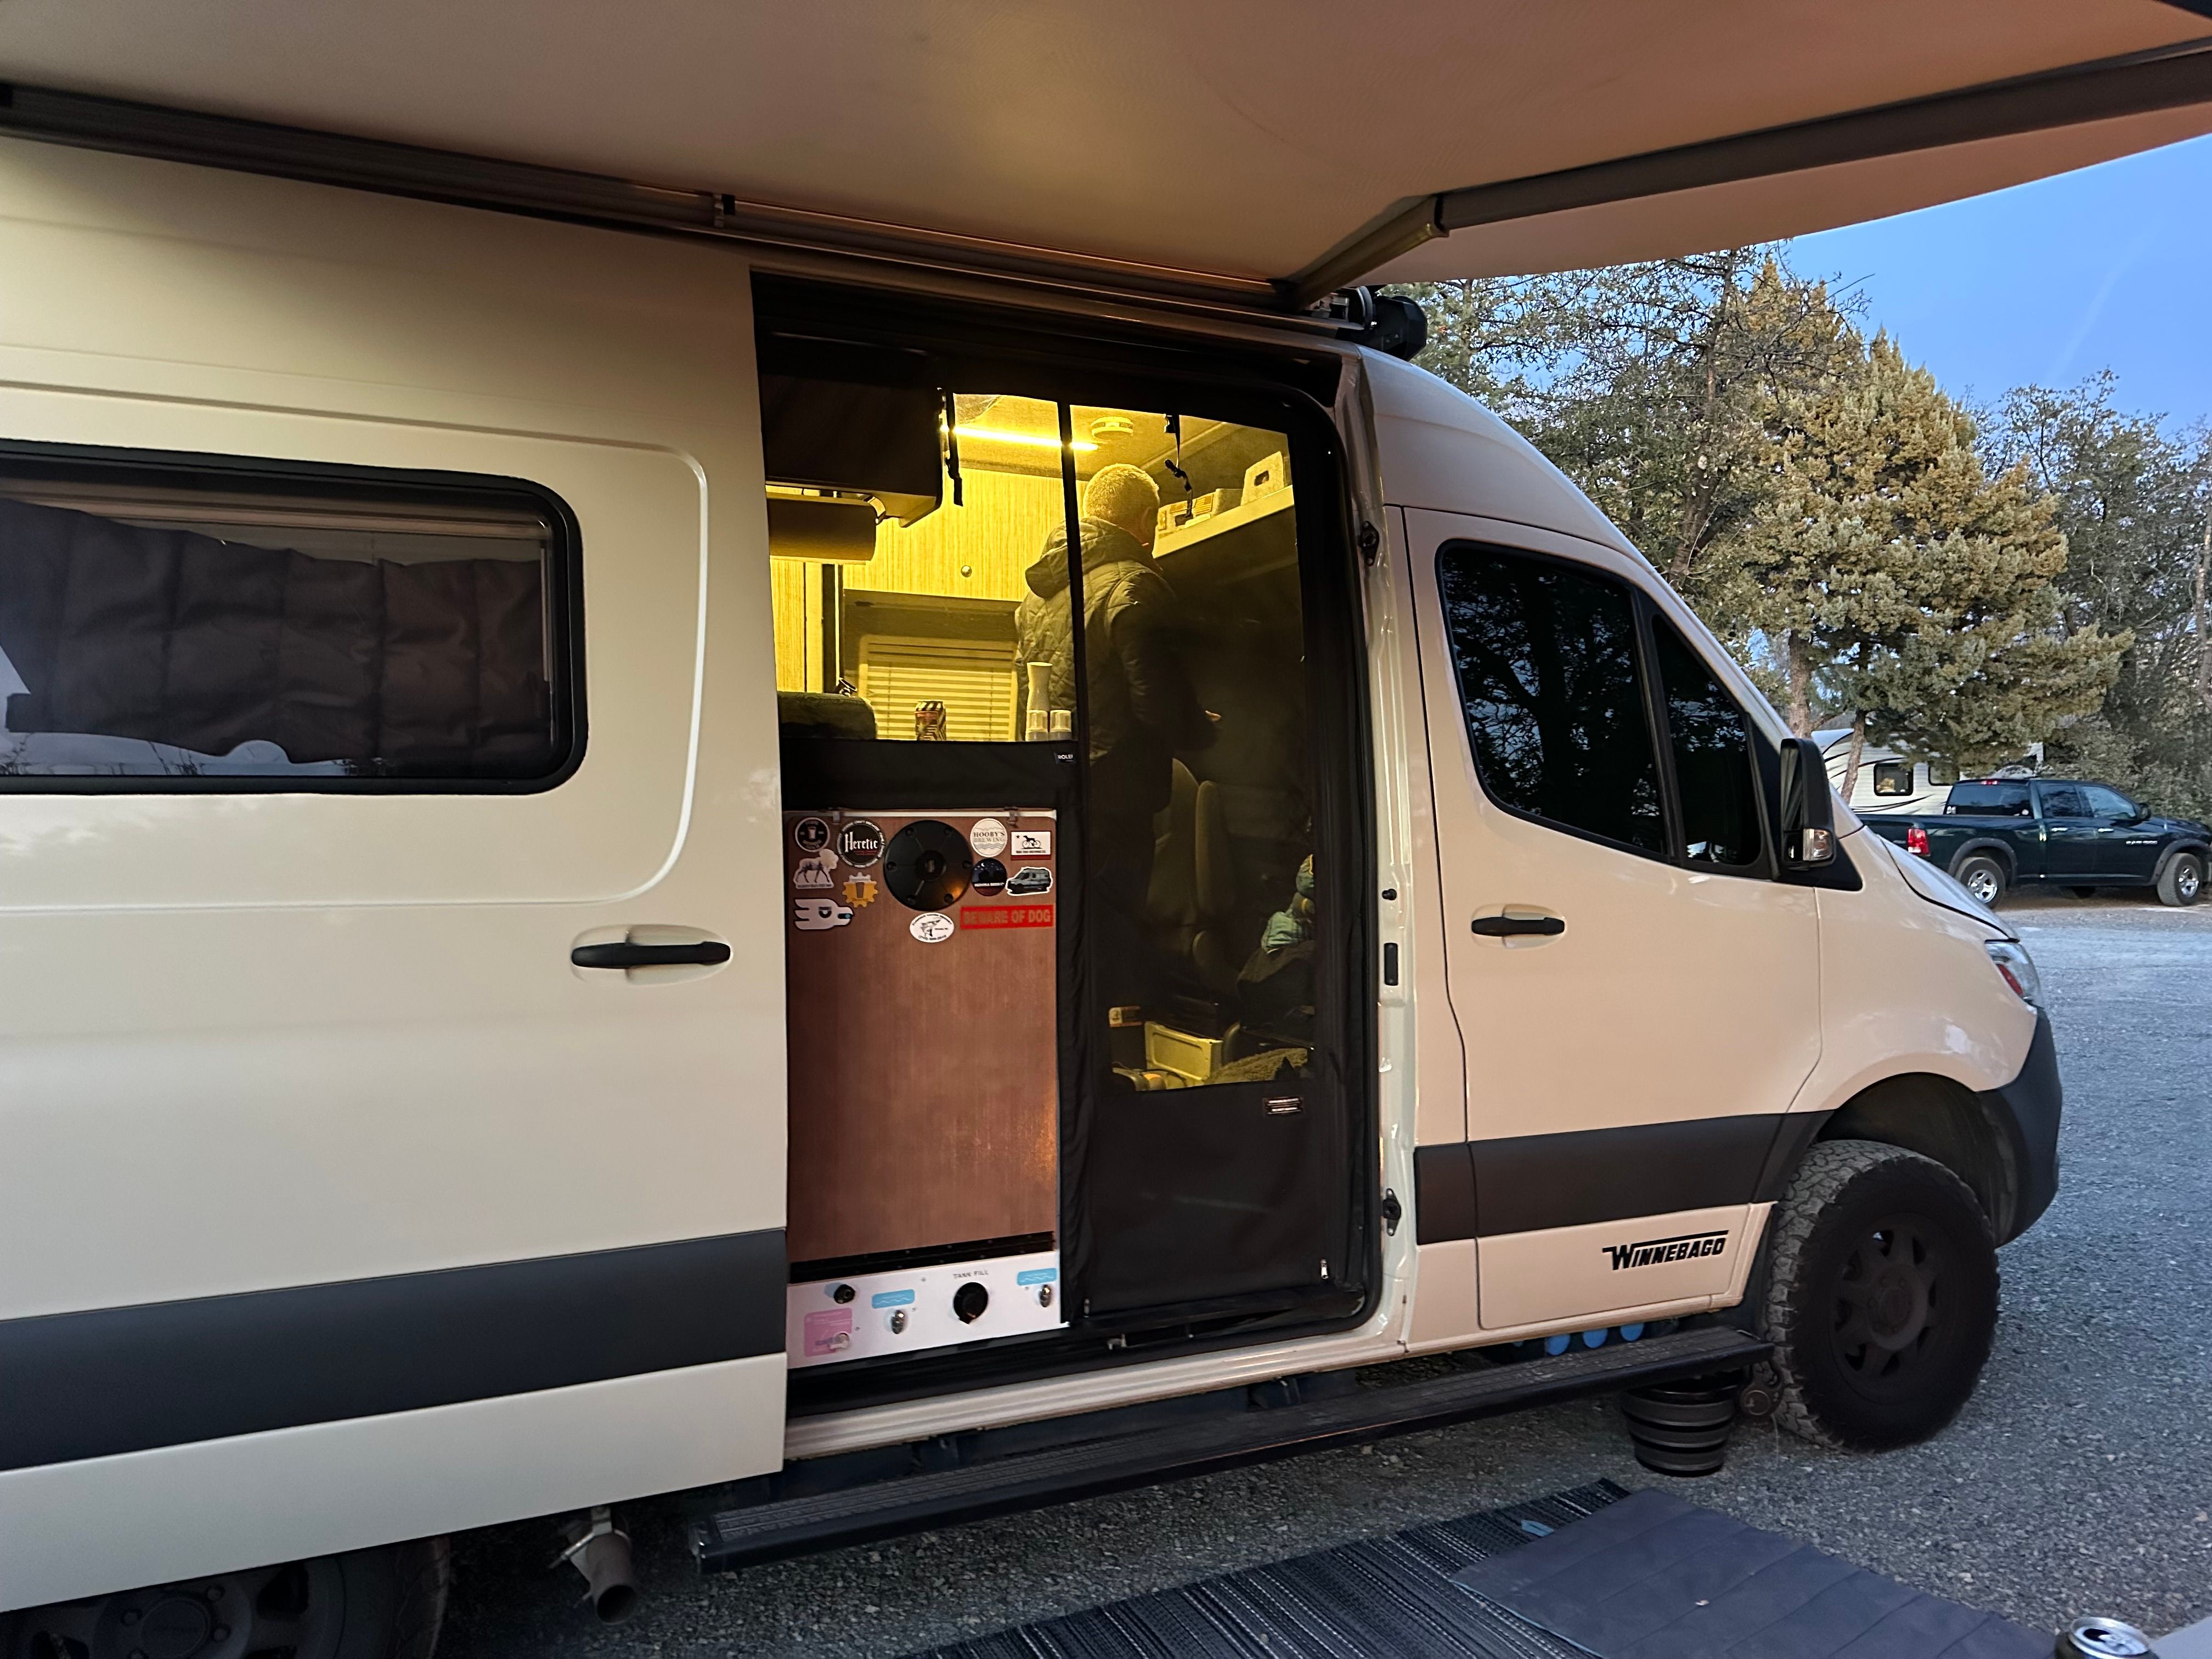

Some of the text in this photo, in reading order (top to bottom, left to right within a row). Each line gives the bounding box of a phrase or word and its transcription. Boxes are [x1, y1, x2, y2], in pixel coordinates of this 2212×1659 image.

[844, 831, 878, 853] Heretic
[963, 910, 1008, 925] BEWARE
[1011, 910, 1026, 923] OF
[1028, 909, 1051, 923] DOG
[1602, 1230, 1729, 1271] WINNEBAGO
